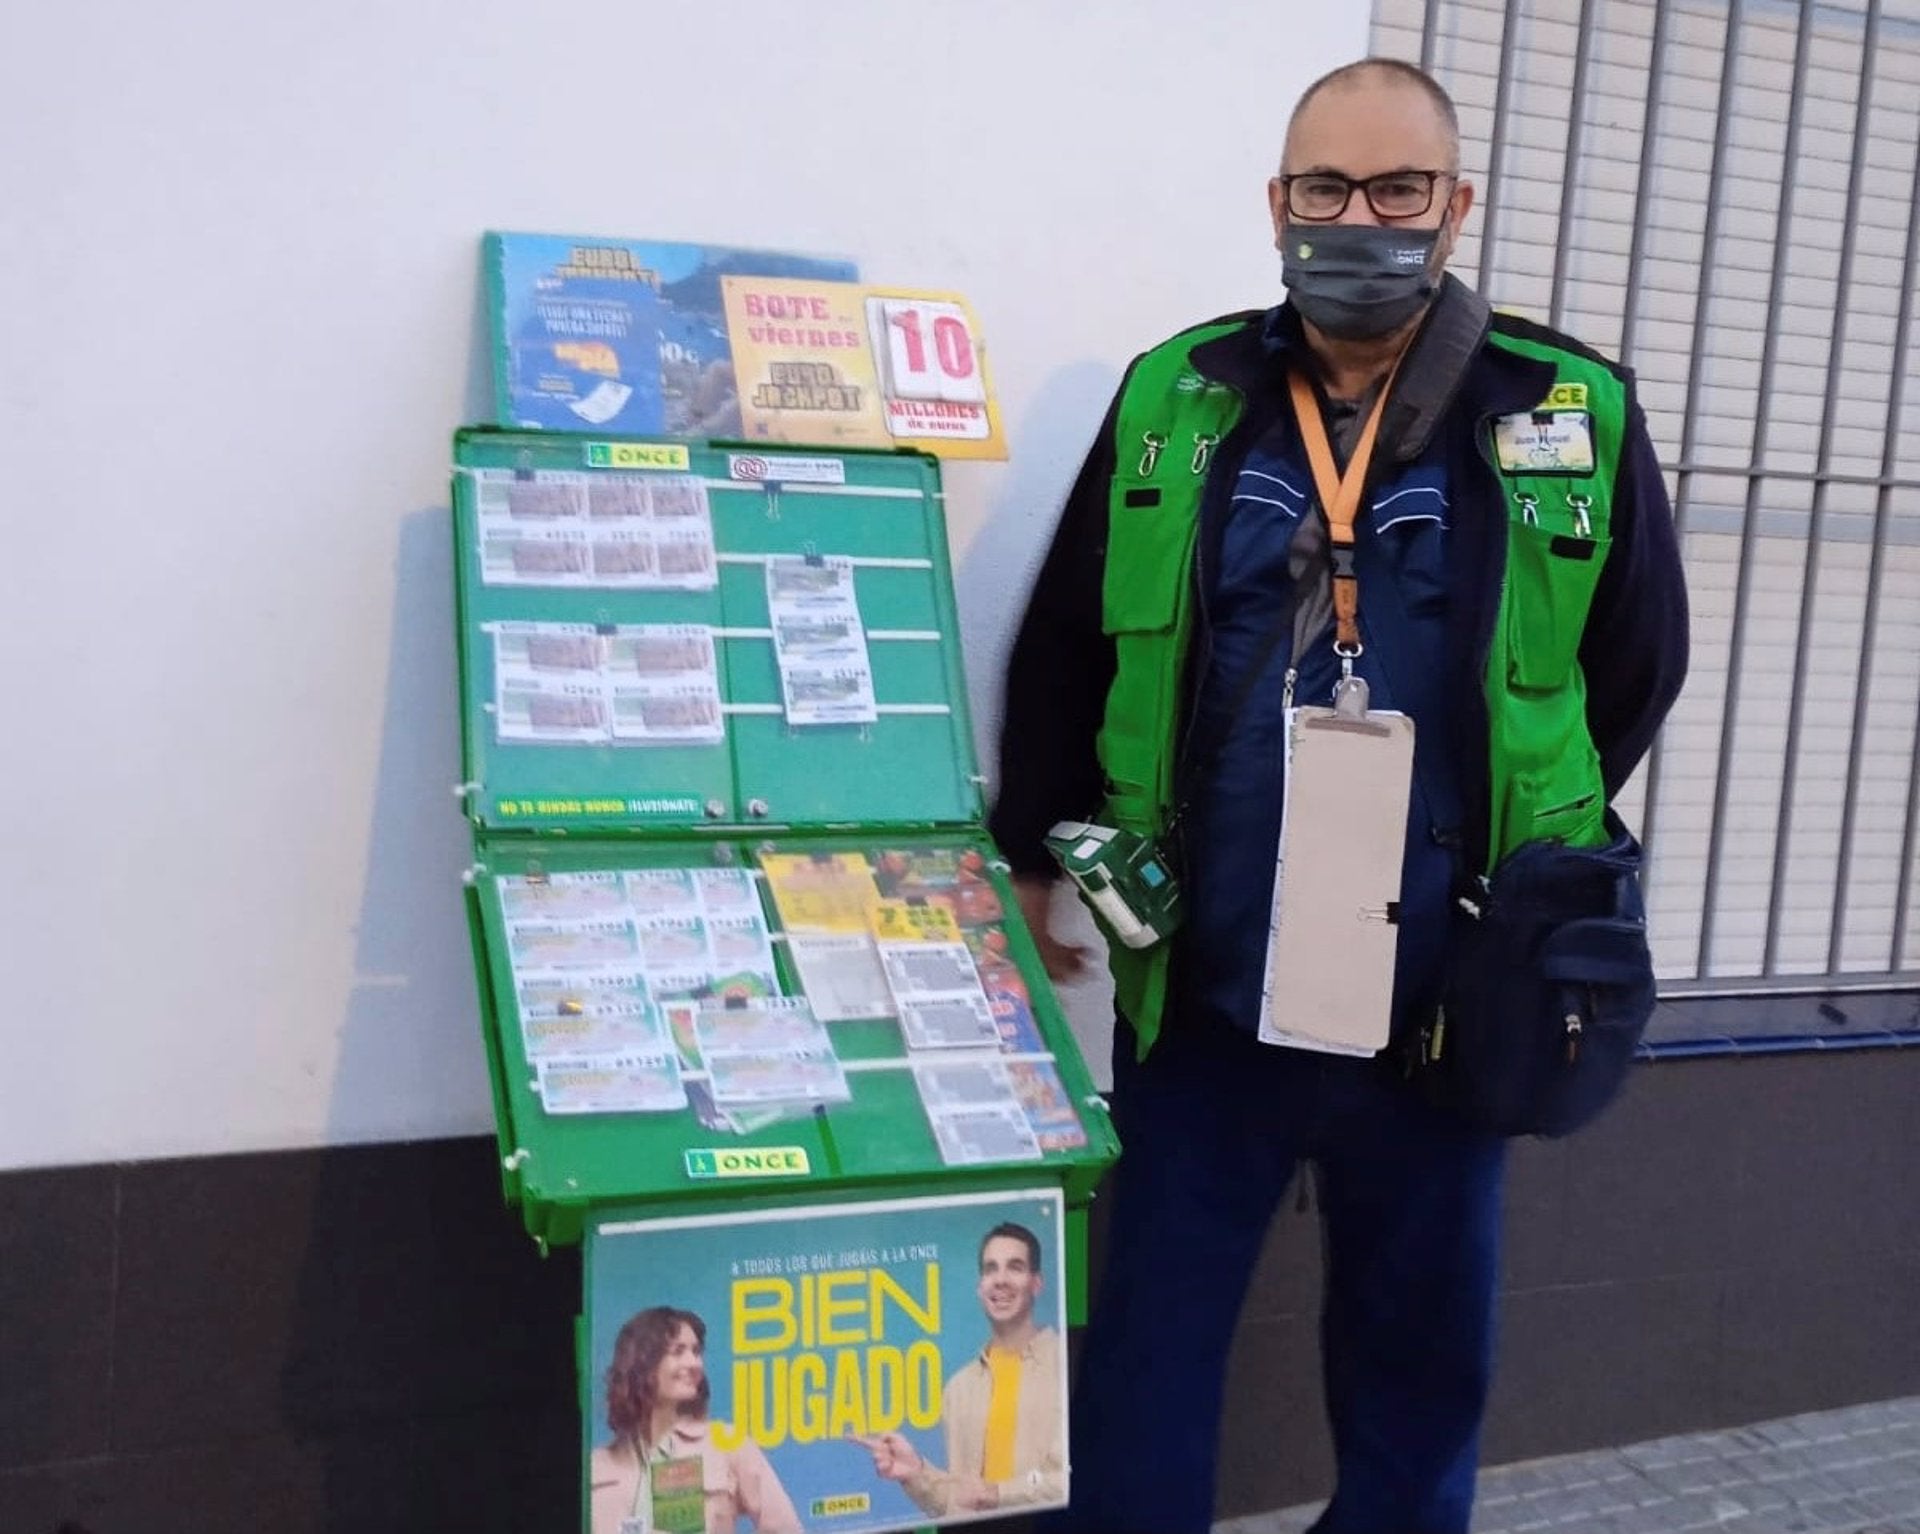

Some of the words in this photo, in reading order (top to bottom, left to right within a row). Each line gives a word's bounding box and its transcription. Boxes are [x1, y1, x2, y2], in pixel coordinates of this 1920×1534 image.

[744, 293, 831, 321] BOTE
[748, 322, 861, 348] viernes
[891, 310, 975, 379] 10
[888, 402, 980, 419] MILLONES
[618, 448, 682, 465] ONCE
[723, 1153, 801, 1169] ONCE
[731, 1262, 941, 1355] BIEN
[710, 1340, 942, 1452] JUGADO
